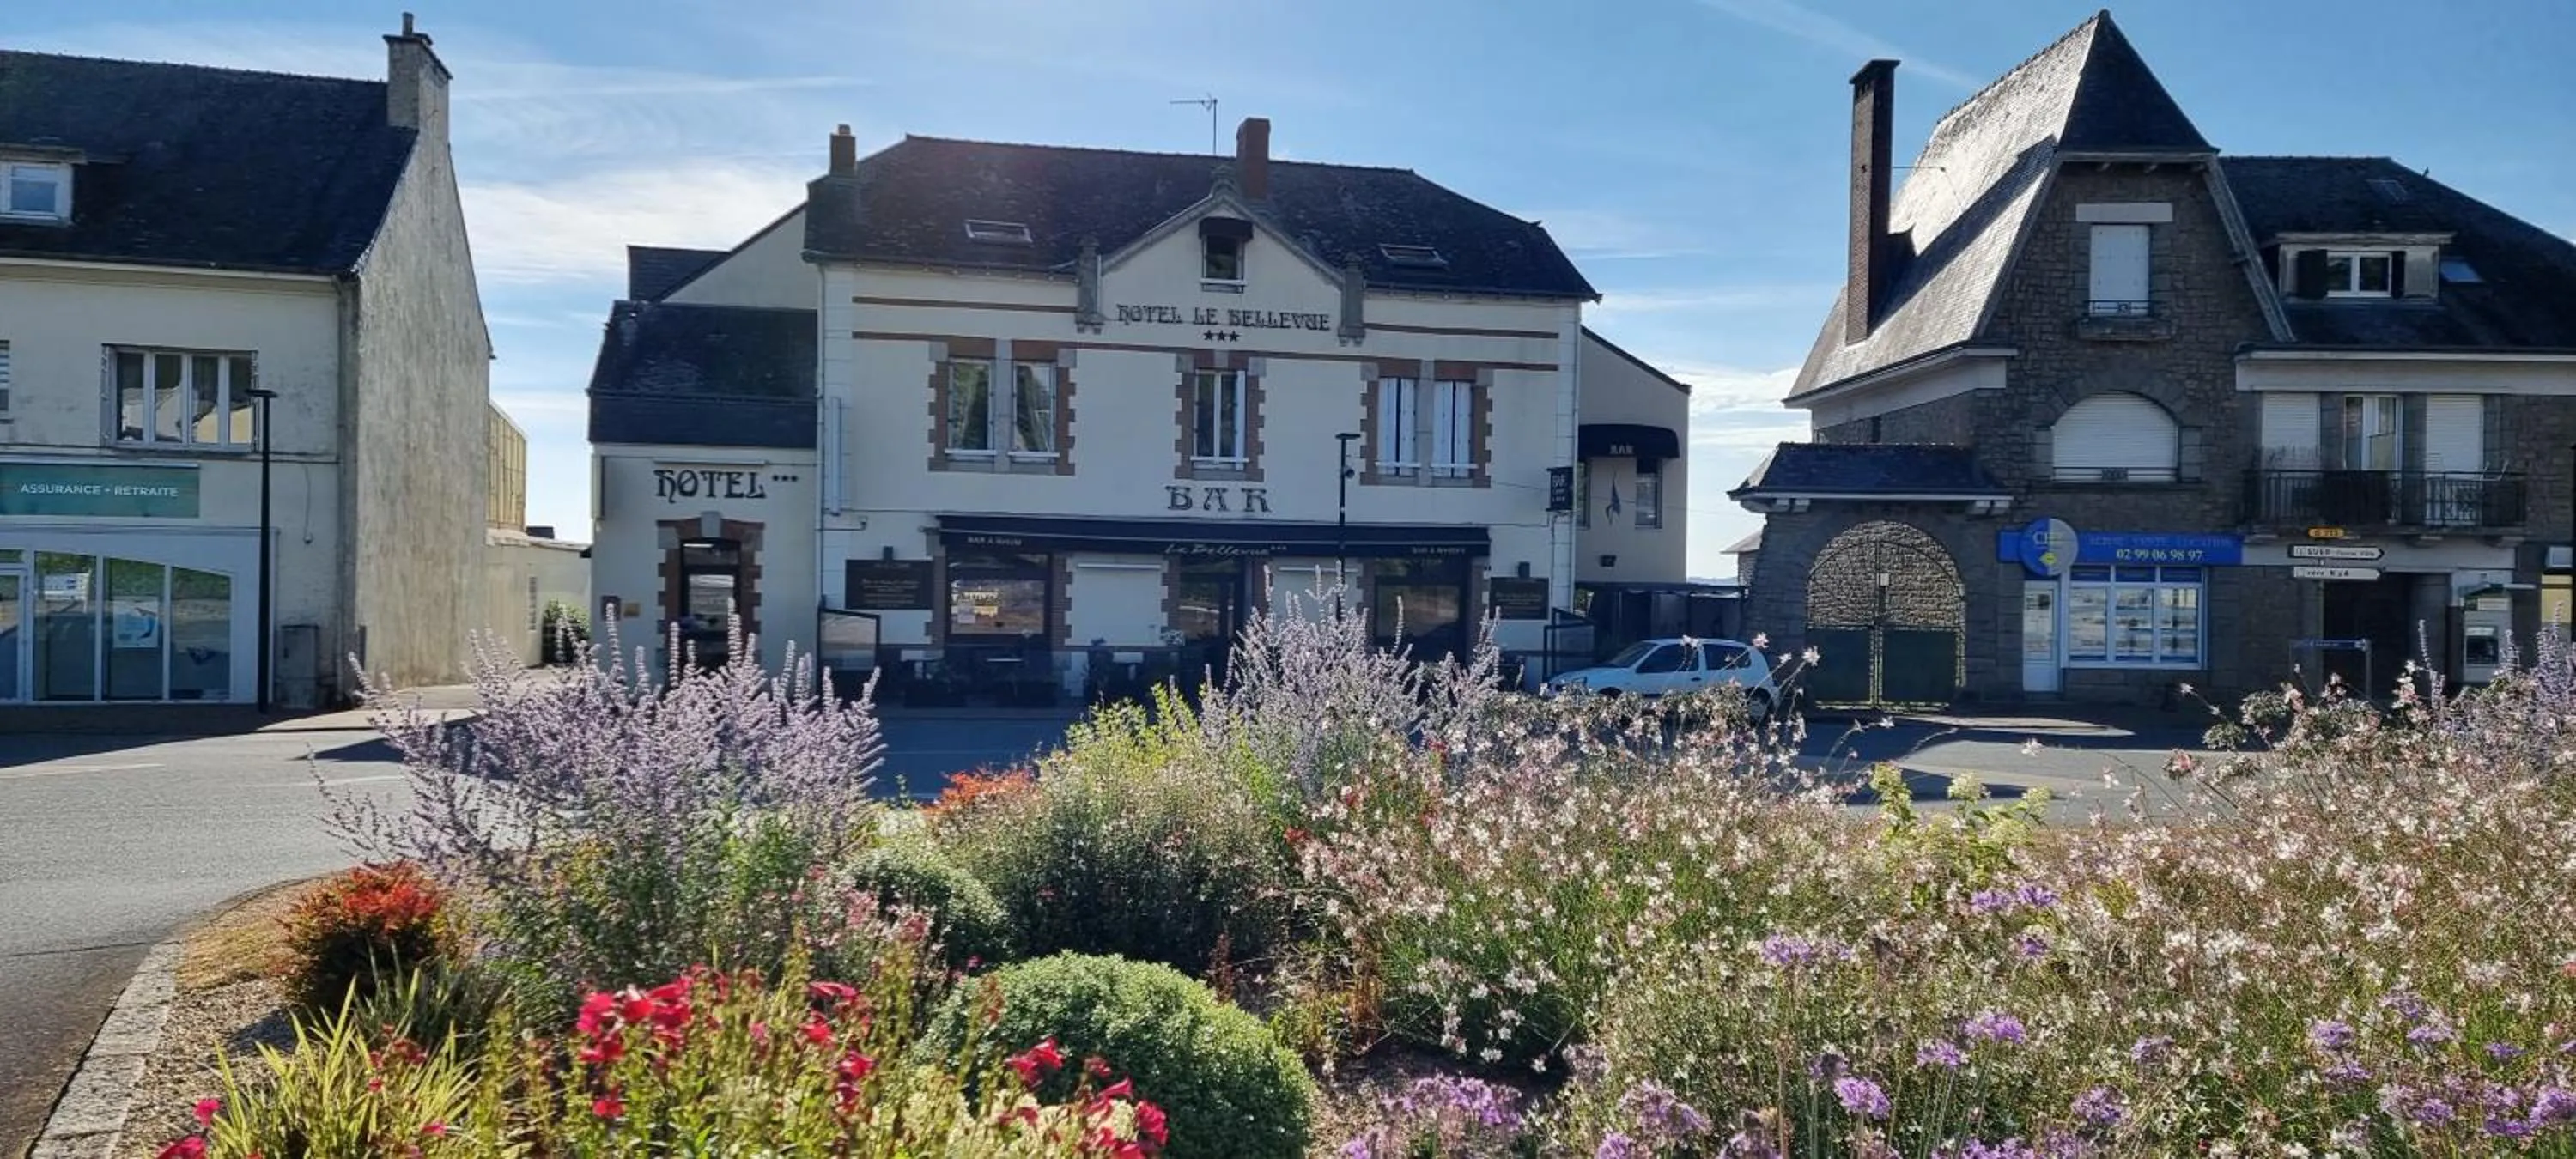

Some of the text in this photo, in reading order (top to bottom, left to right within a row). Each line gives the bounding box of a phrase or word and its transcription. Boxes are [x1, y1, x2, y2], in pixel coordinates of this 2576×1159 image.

[1193, 306, 1218, 325] LE
[1227, 309, 1330, 331] BELLEVUE
[1610, 444, 1634, 455] BAR
[20, 483, 179, 497] ASSURANCE RETRAITE
[653, 470, 766, 504] HOTEL
[1164, 485, 1272, 513] BAR
[1165, 543, 1270, 555] Le Bellevue
[2116, 549, 2203, 561] 02 99 06 98 97
